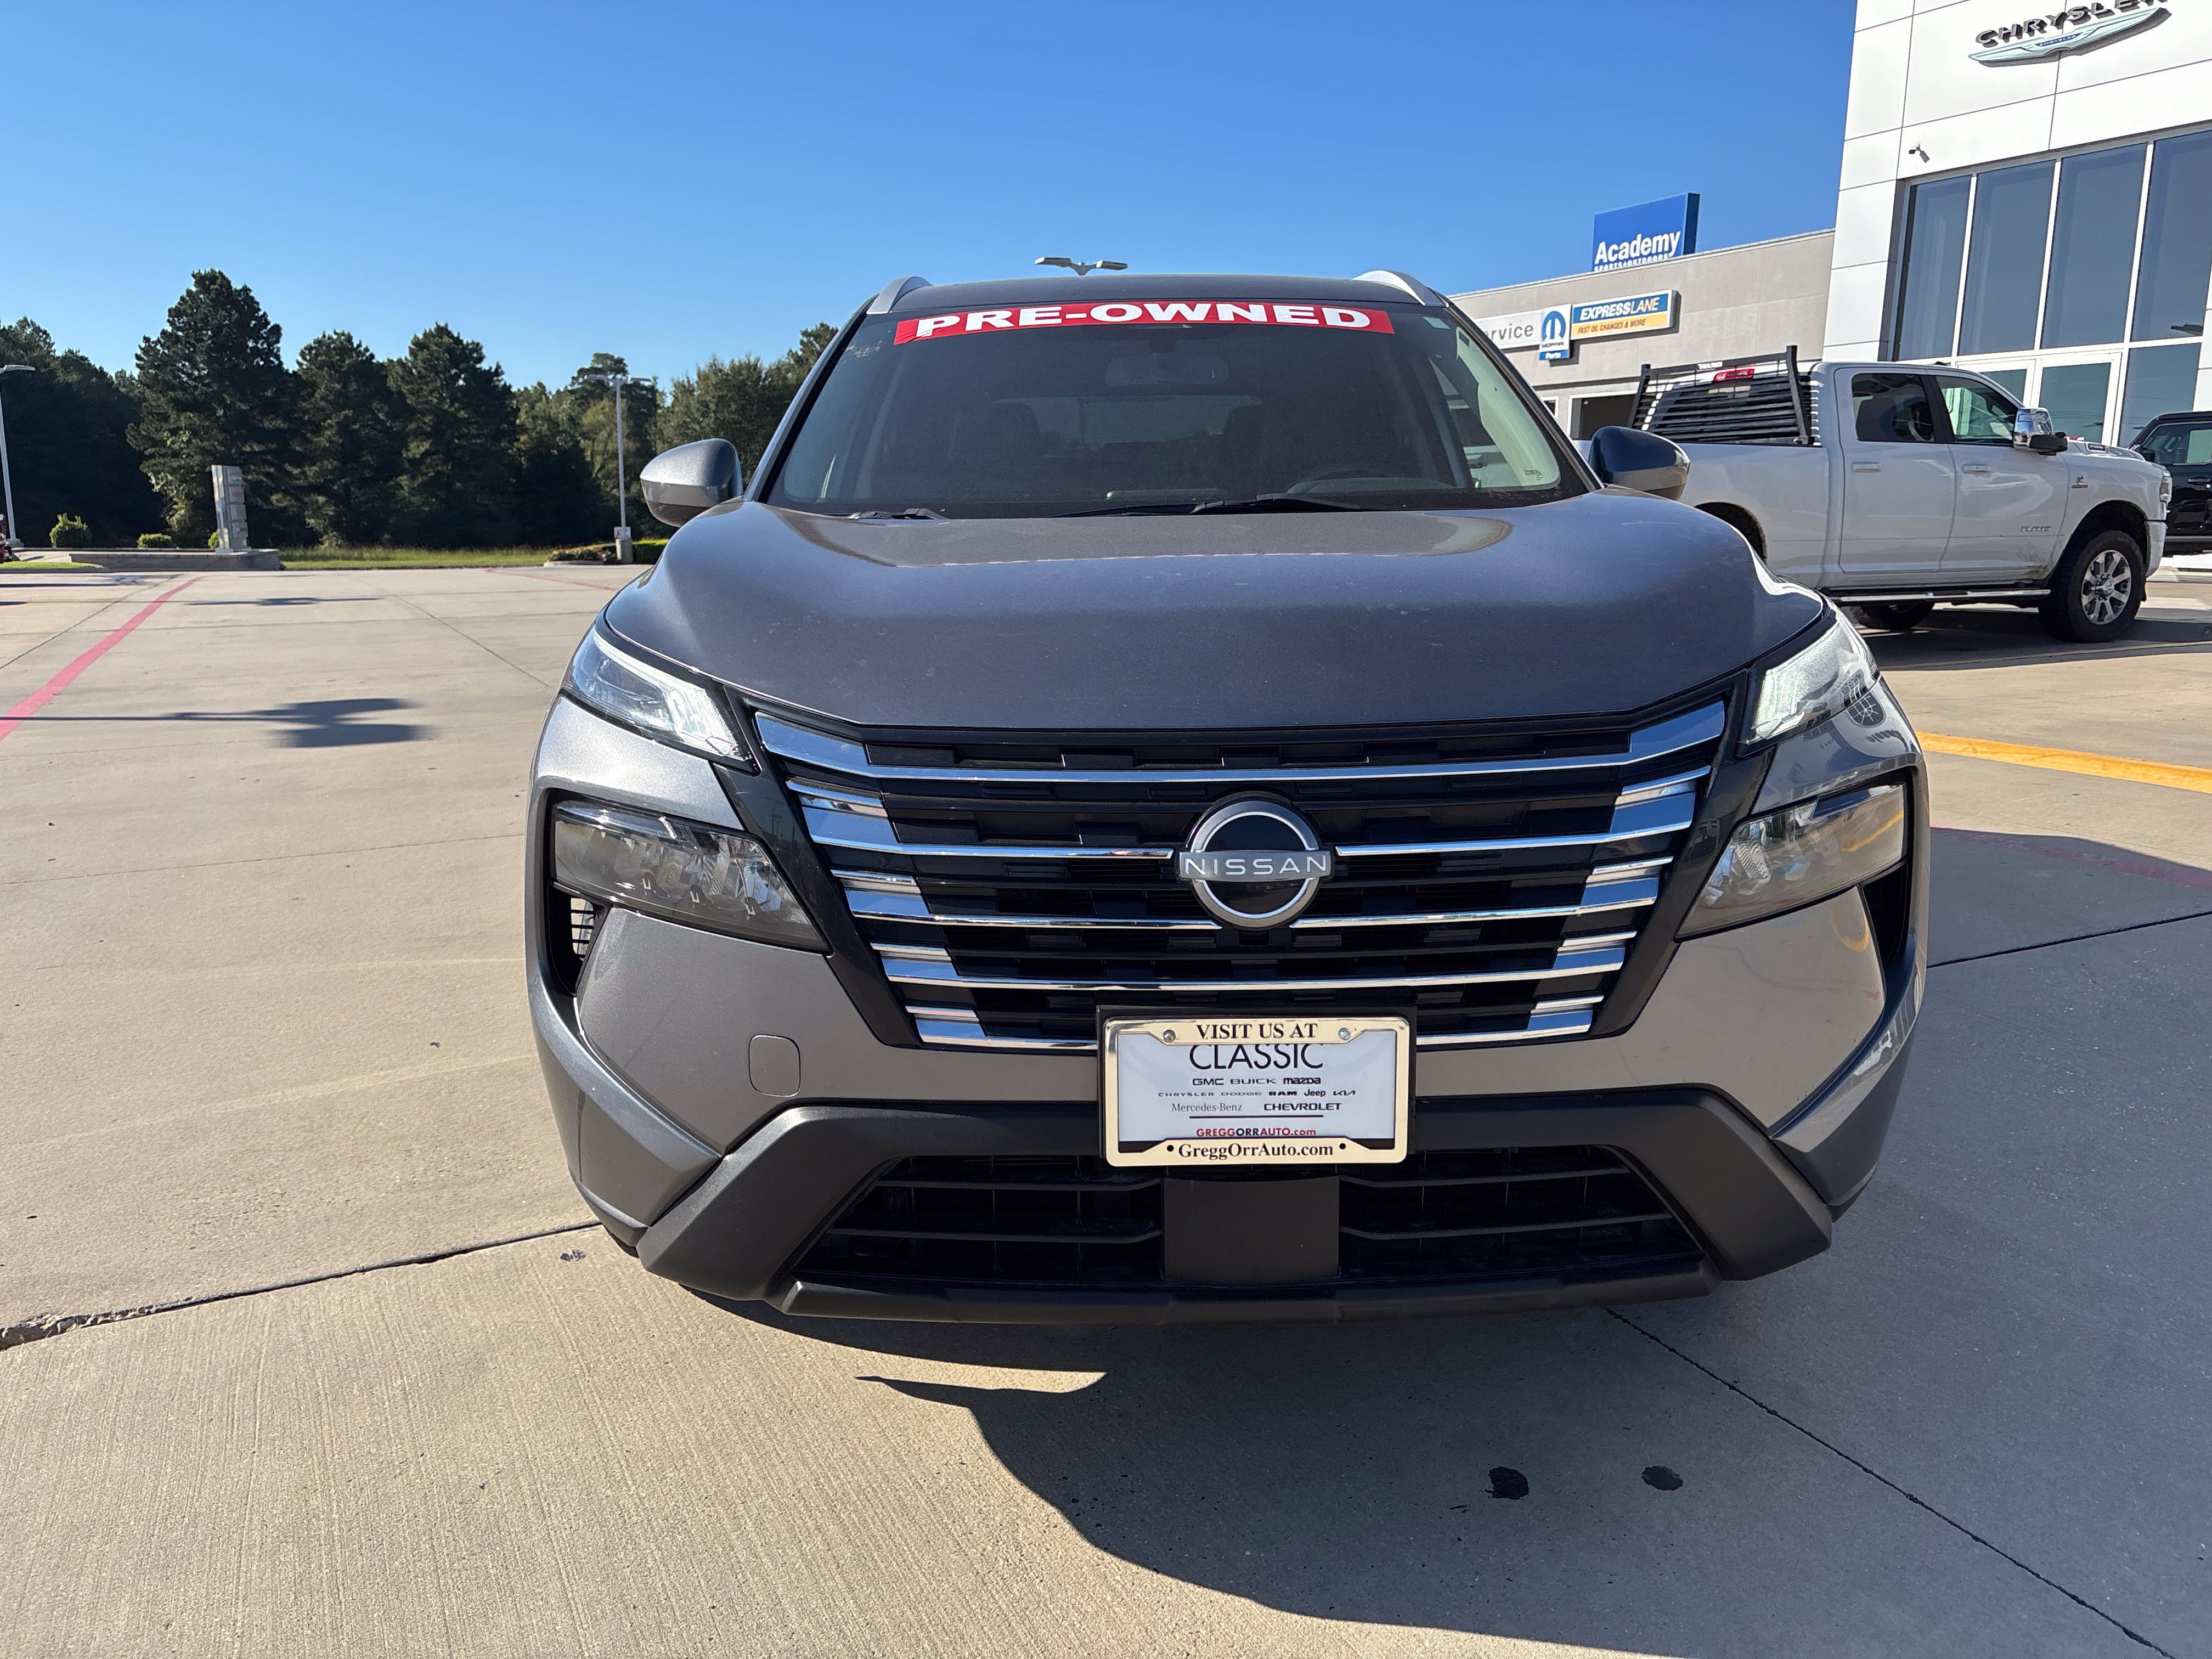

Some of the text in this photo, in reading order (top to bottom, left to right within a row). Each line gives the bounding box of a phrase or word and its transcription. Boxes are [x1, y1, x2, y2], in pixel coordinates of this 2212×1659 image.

[1975, 0, 2166, 45] CHRYSLE
[1594, 231, 1681, 264] Academy
[916, 303, 1370, 337] PRE-OWNED
[1630, 319, 1646, 327] MORE
[1184, 855, 1326, 876] NISSAN
[1195, 1023, 1318, 1040] VISIT US AT
[1189, 1043, 1323, 1069] CLASSIC
[1304, 1089, 1326, 1097] Jeep
[1171, 1102, 1342, 1113] Mercedes-Benz CHEVROLET
[1196, 1127, 1317, 1137] GREGGORRAUTO.com
[1178, 1143, 1334, 1160] GreggOrrAuto.com
